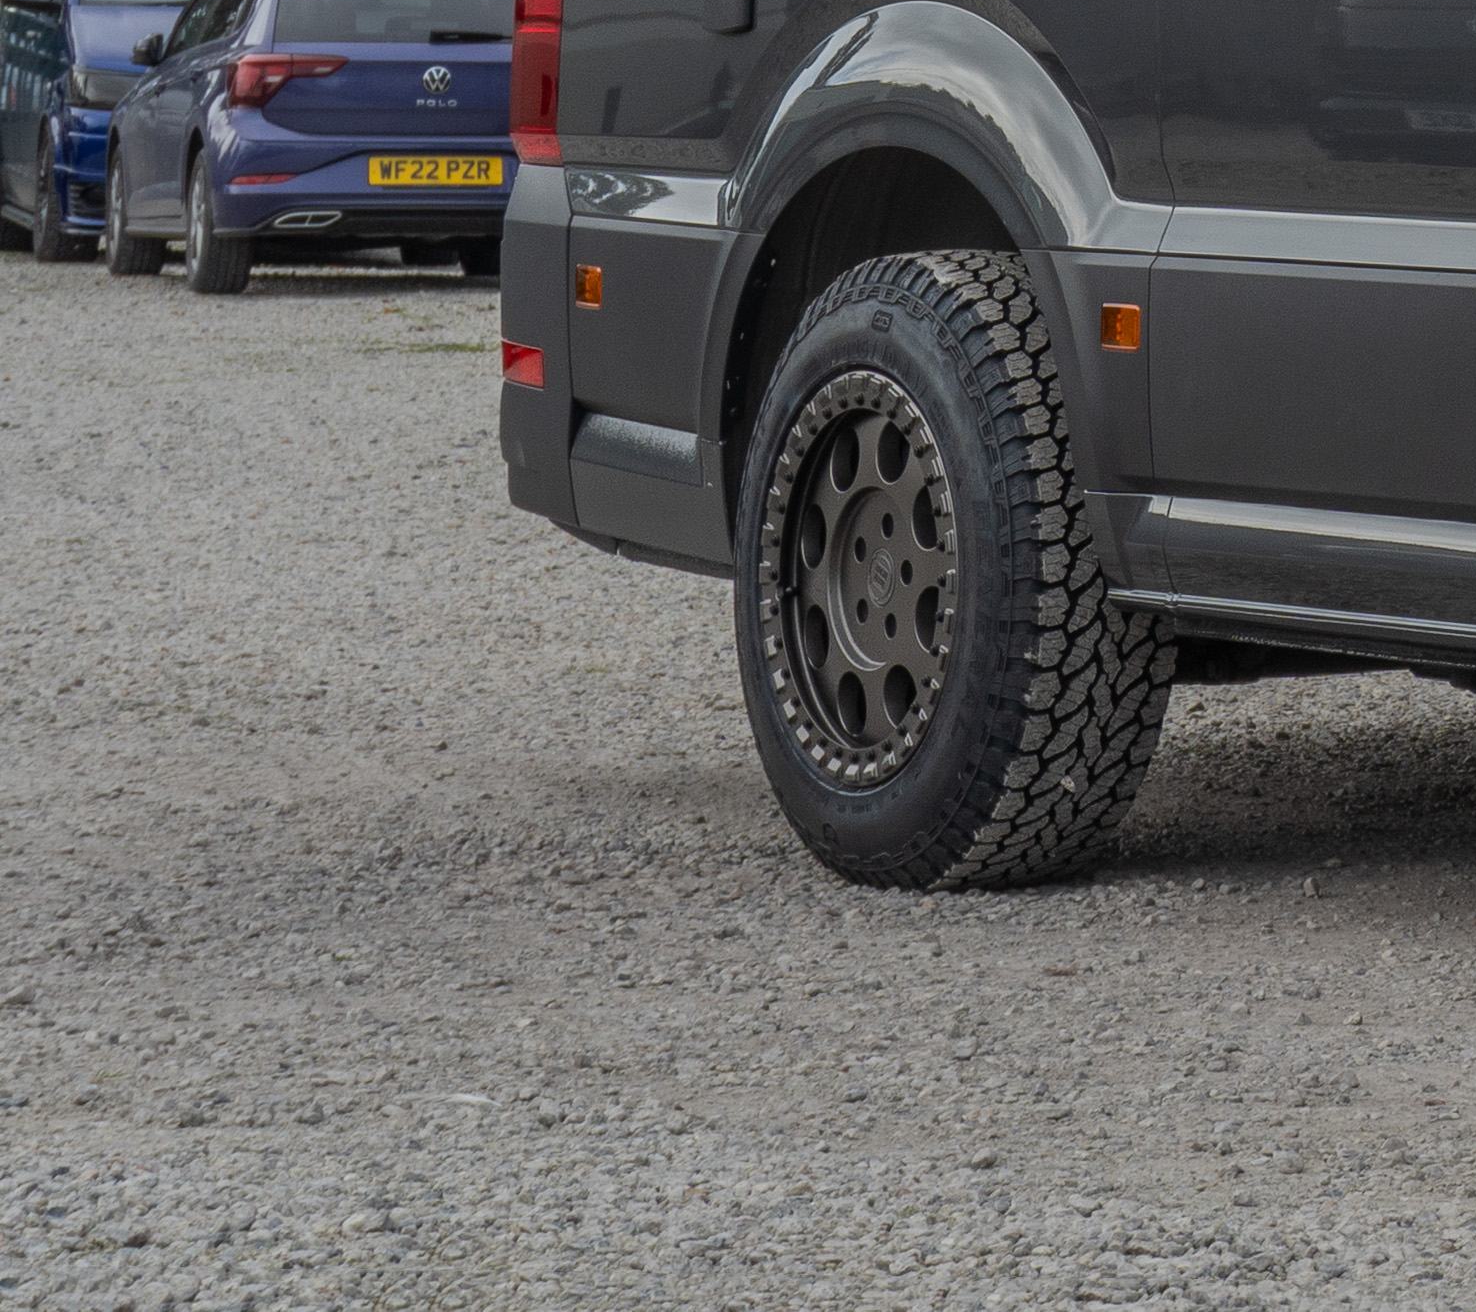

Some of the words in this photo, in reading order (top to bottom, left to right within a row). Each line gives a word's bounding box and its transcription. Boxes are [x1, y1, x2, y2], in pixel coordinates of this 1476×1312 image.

[416, 99, 457, 107] POLO
[379, 160, 439, 180] WF22
[446, 160, 490, 180] PZR
